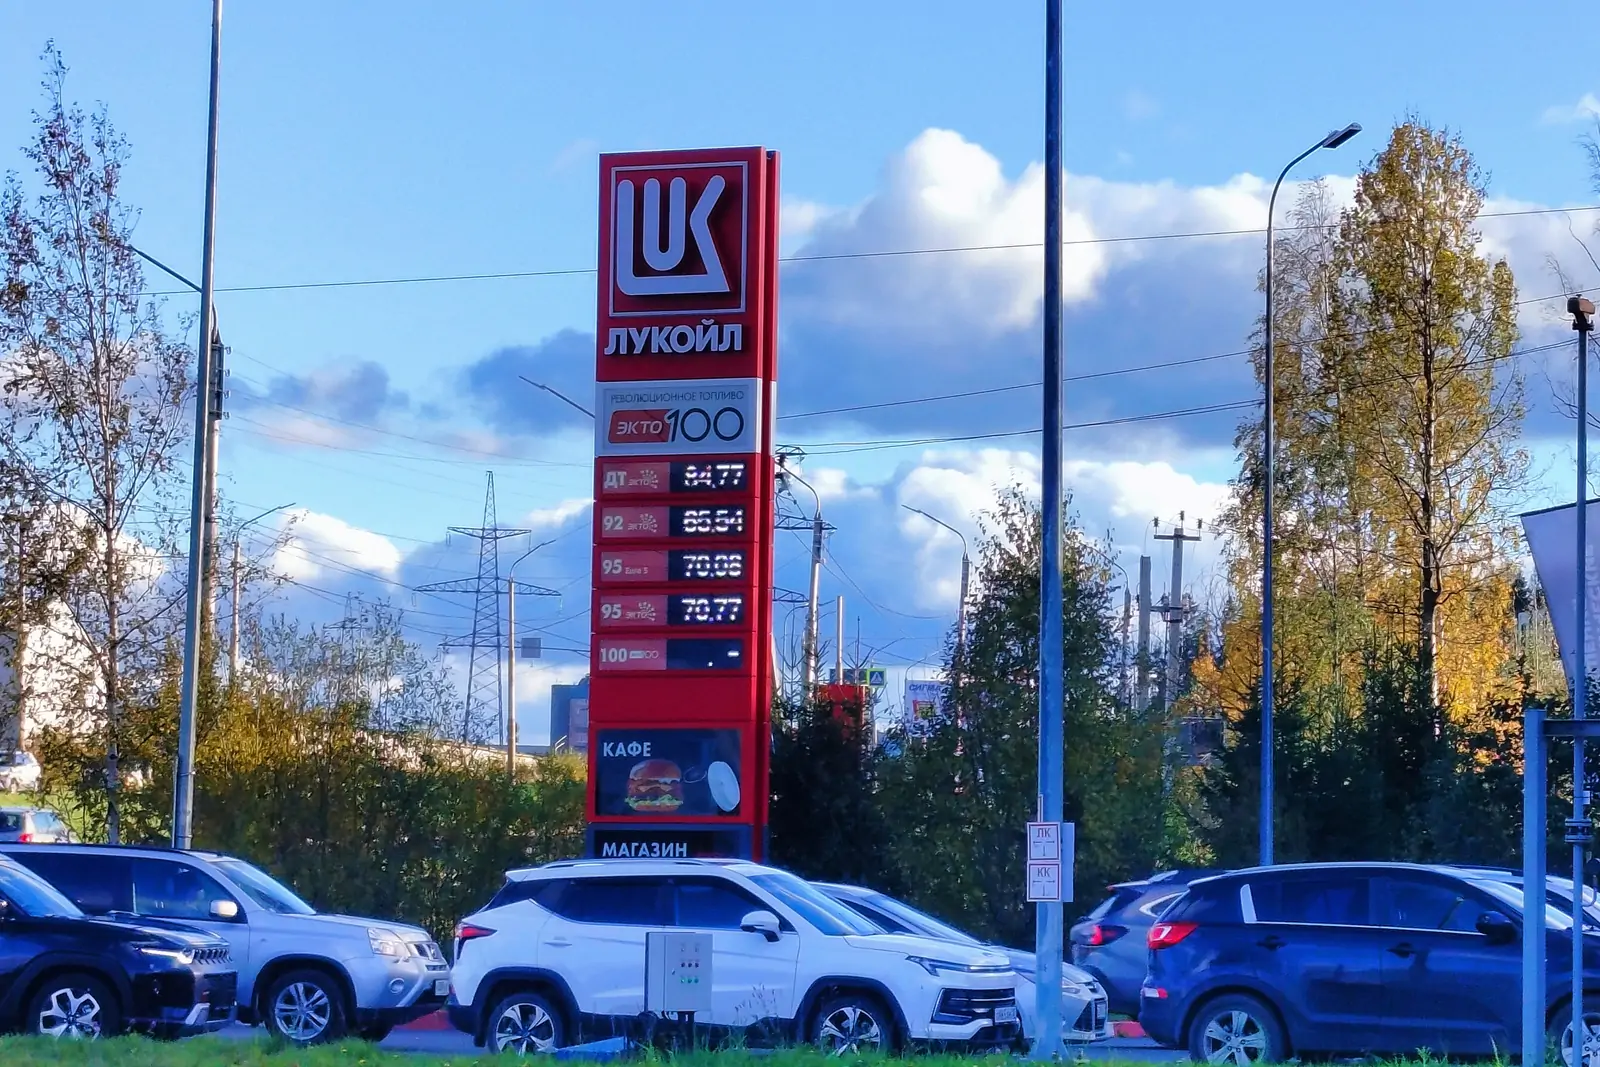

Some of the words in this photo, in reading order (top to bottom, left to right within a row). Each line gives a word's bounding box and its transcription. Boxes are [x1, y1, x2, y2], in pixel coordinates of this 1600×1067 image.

[604, 318, 742, 355] ЛУКОЙЛ
[610, 391, 696, 404] РЕВОЛЮЦИОННОЕ
[699, 390, 744, 401] ТОПЛИВО
[616, 420, 663, 435] ЭКТО
[665, 407, 744, 442] 100
[604, 471, 627, 488] ДТ
[603, 516, 624, 531] 92
[602, 559, 623, 575] 95
[601, 603, 622, 620] 95
[681, 598, 742, 621] 70.77
[601, 648, 628, 663] 100
[603, 741, 652, 757] КАФЕ
[1036, 827, 1052, 838] ЛК
[602, 842, 688, 858] МАГАЗИН
[1037, 867, 1051, 878] КК
